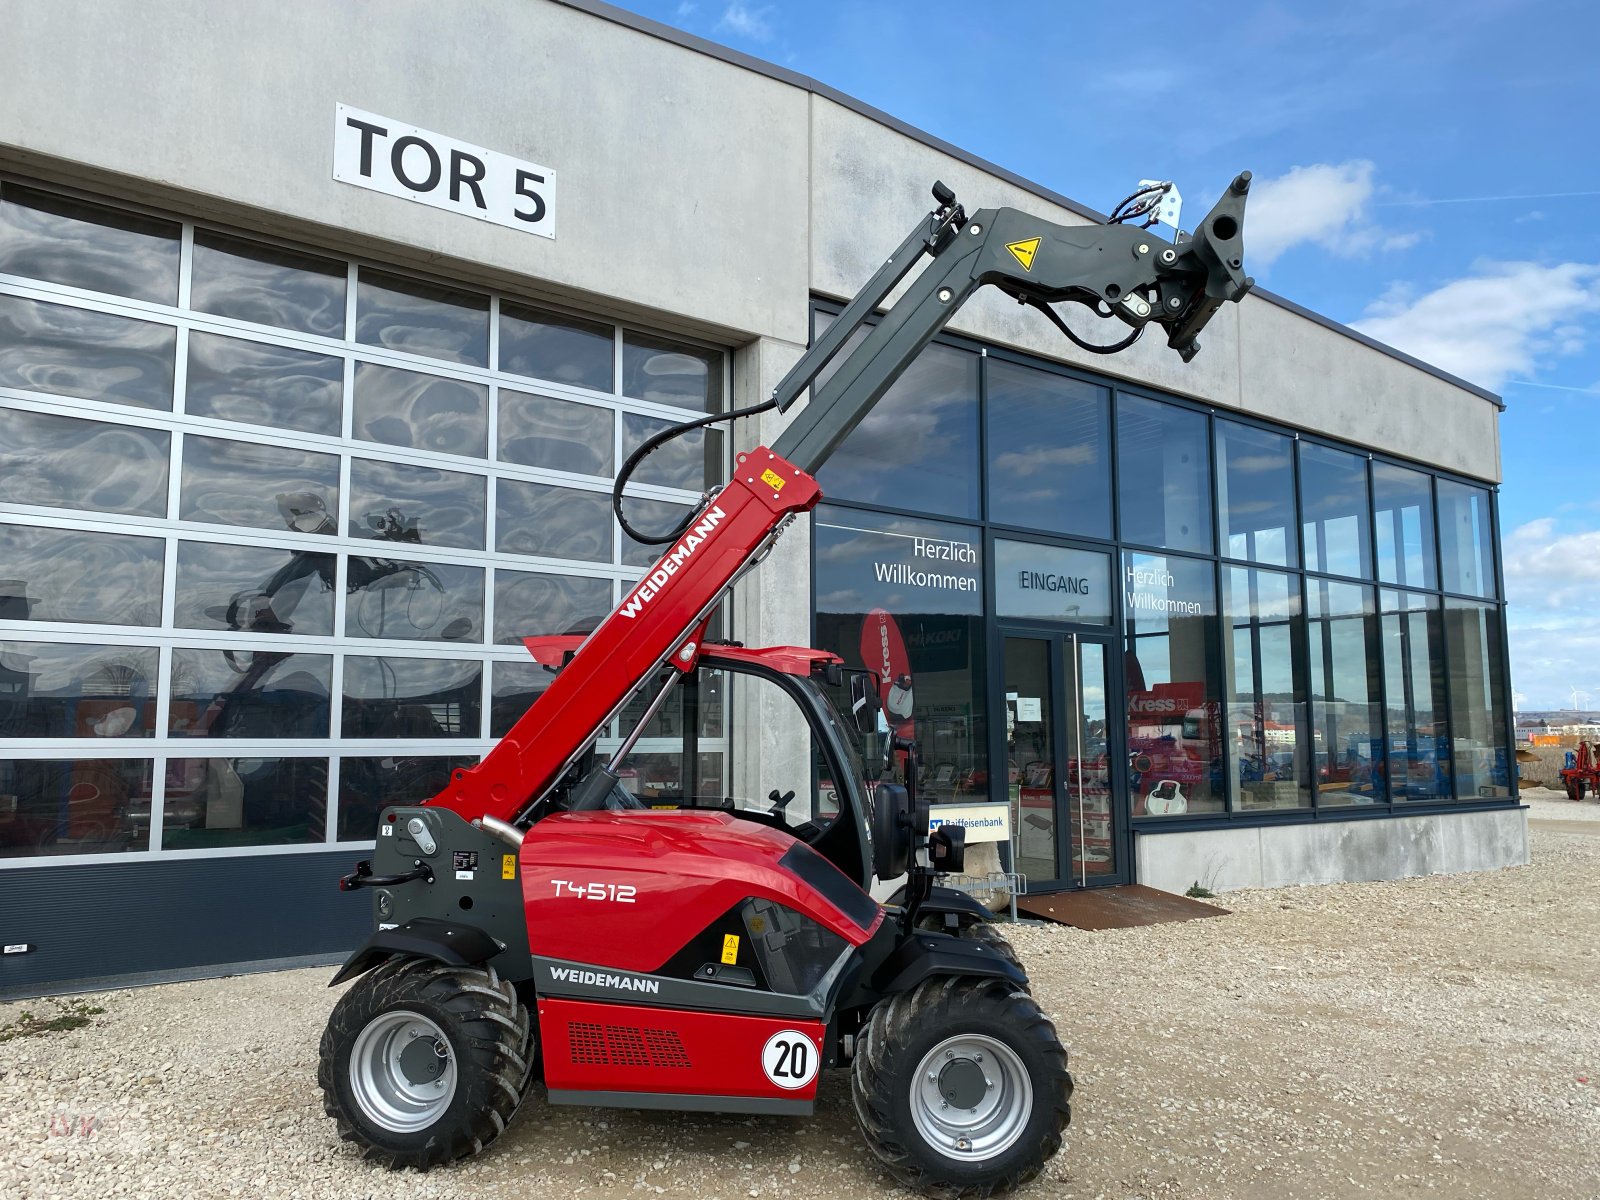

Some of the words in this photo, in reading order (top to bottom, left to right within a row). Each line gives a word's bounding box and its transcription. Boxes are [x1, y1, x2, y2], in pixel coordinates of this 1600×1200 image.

[346, 116, 488, 210] TOR
[513, 168, 546, 223] 5
[619, 505, 727, 619] WEIDEMANN
[914, 538, 976, 563] Herzlich
[874, 562, 977, 592] Willkommen
[1020, 570, 1089, 595] EINGANG
[1127, 566, 1175, 588] Herzlich
[1127, 591, 1201, 615] Willkommen
[880, 624, 892, 684] Kress
[1127, 694, 1176, 713] Kress
[945, 816, 1004, 828] Raiffeisenbank
[551, 879, 638, 904] T4512
[550, 966, 660, 994] WEIDEMANN
[773, 1040, 808, 1079] 20
